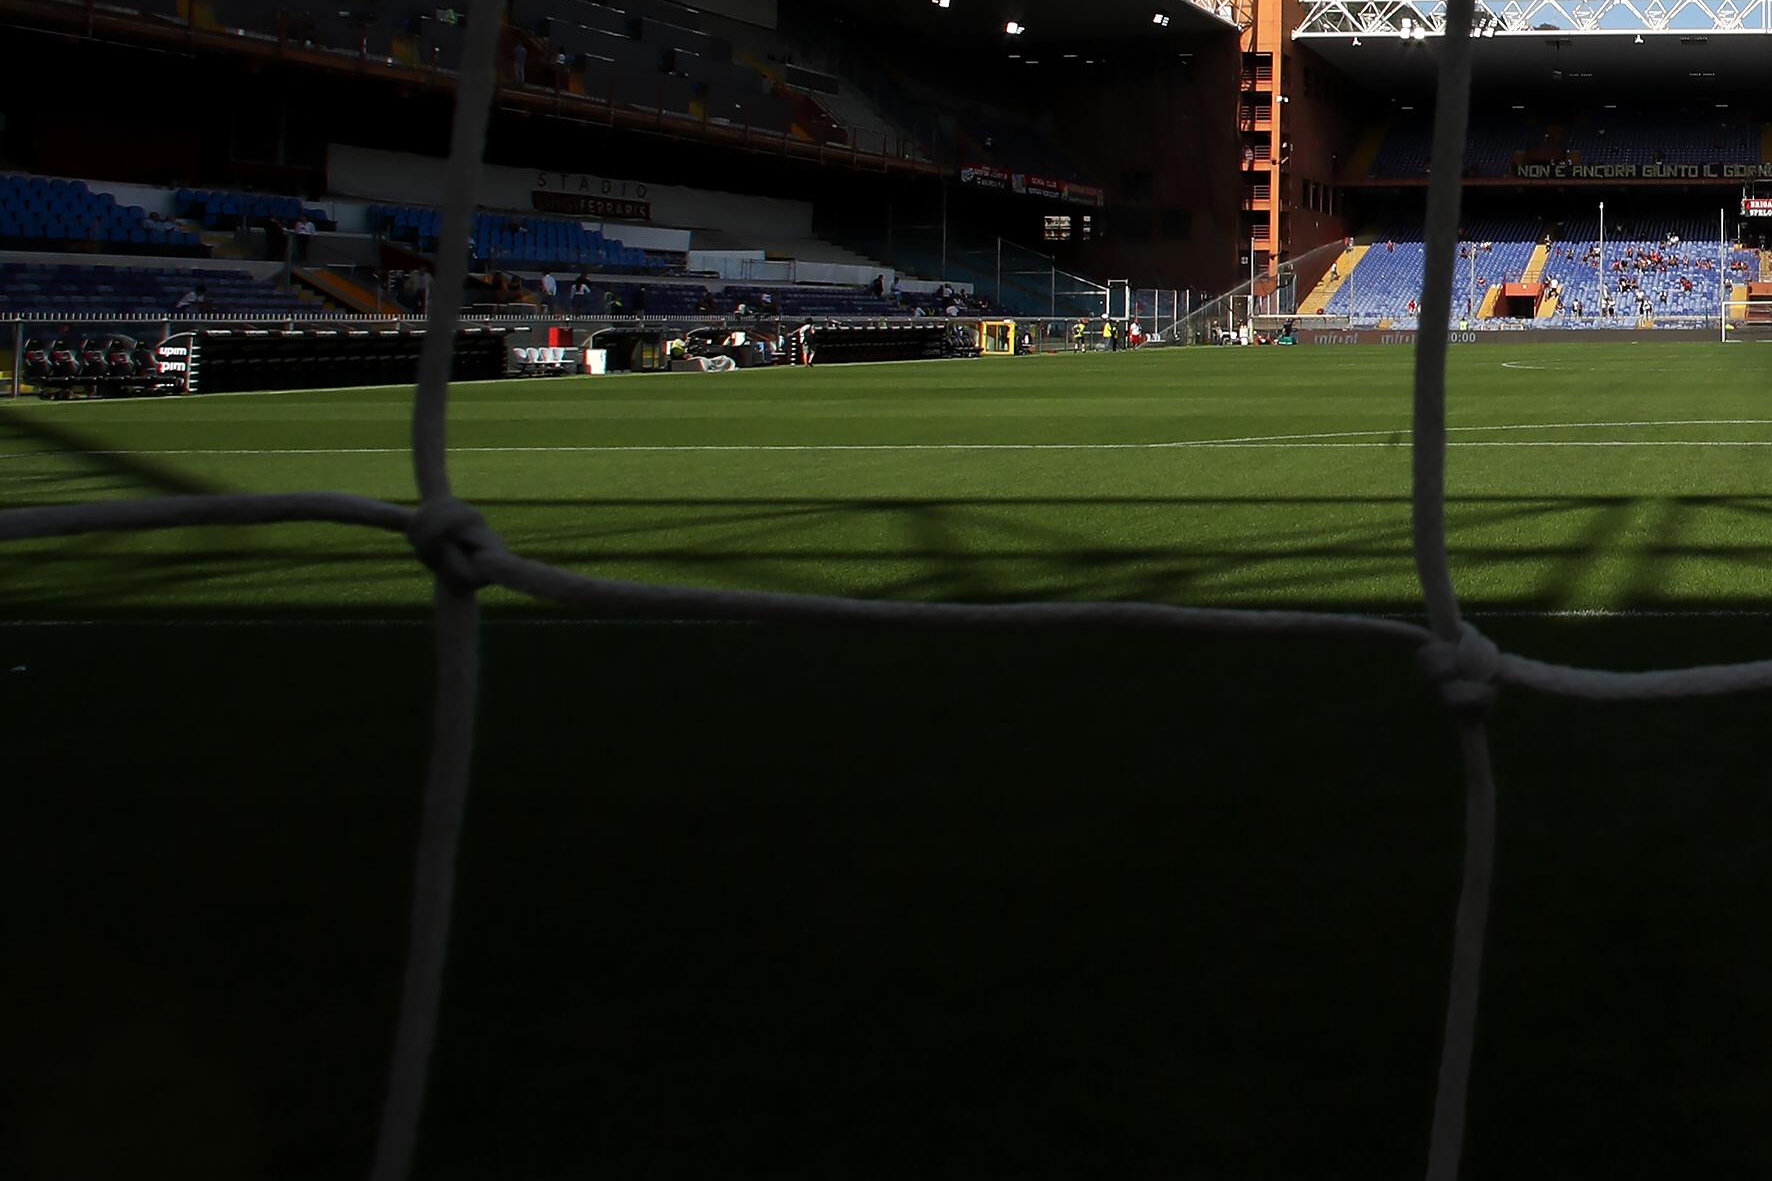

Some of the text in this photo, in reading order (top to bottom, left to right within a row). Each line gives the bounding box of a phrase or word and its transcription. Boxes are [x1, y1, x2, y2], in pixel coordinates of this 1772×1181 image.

[1517, 164, 1550, 178] NON
[1572, 164, 1636, 178] ANCORA
[1642, 164, 1699, 178] GIUNTO
[1703, 164, 1718, 178] IL
[537, 172, 647, 198] STADIO
[1448, 332, 1476, 342] 0:00
[159, 346, 187, 357] upim
[160, 362, 186, 373] pim
